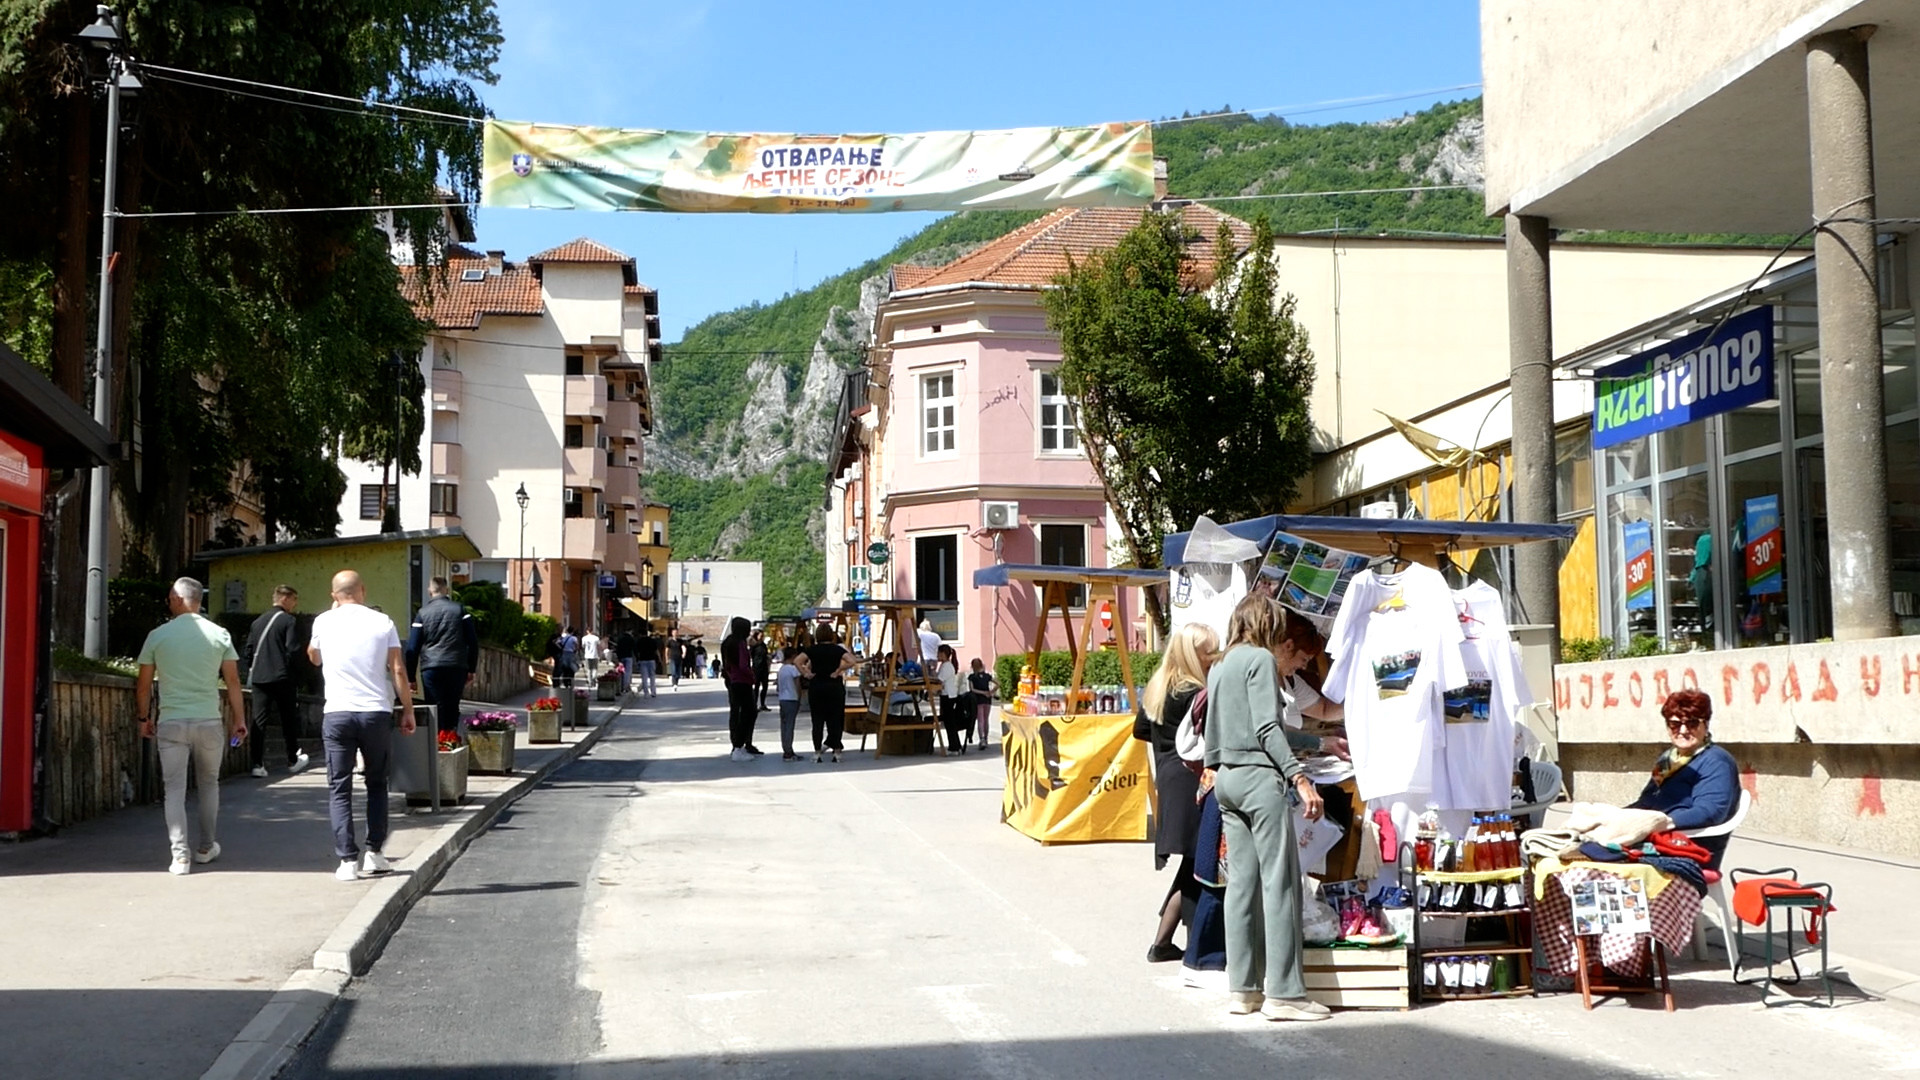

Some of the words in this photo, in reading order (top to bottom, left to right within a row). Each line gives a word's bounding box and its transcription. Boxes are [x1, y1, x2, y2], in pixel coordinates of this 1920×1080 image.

[762, 147, 884, 168] ОТВАРАЊЕ
[1721, 658, 1839, 706] ГРАД
[1861, 654, 1881, 697] У
